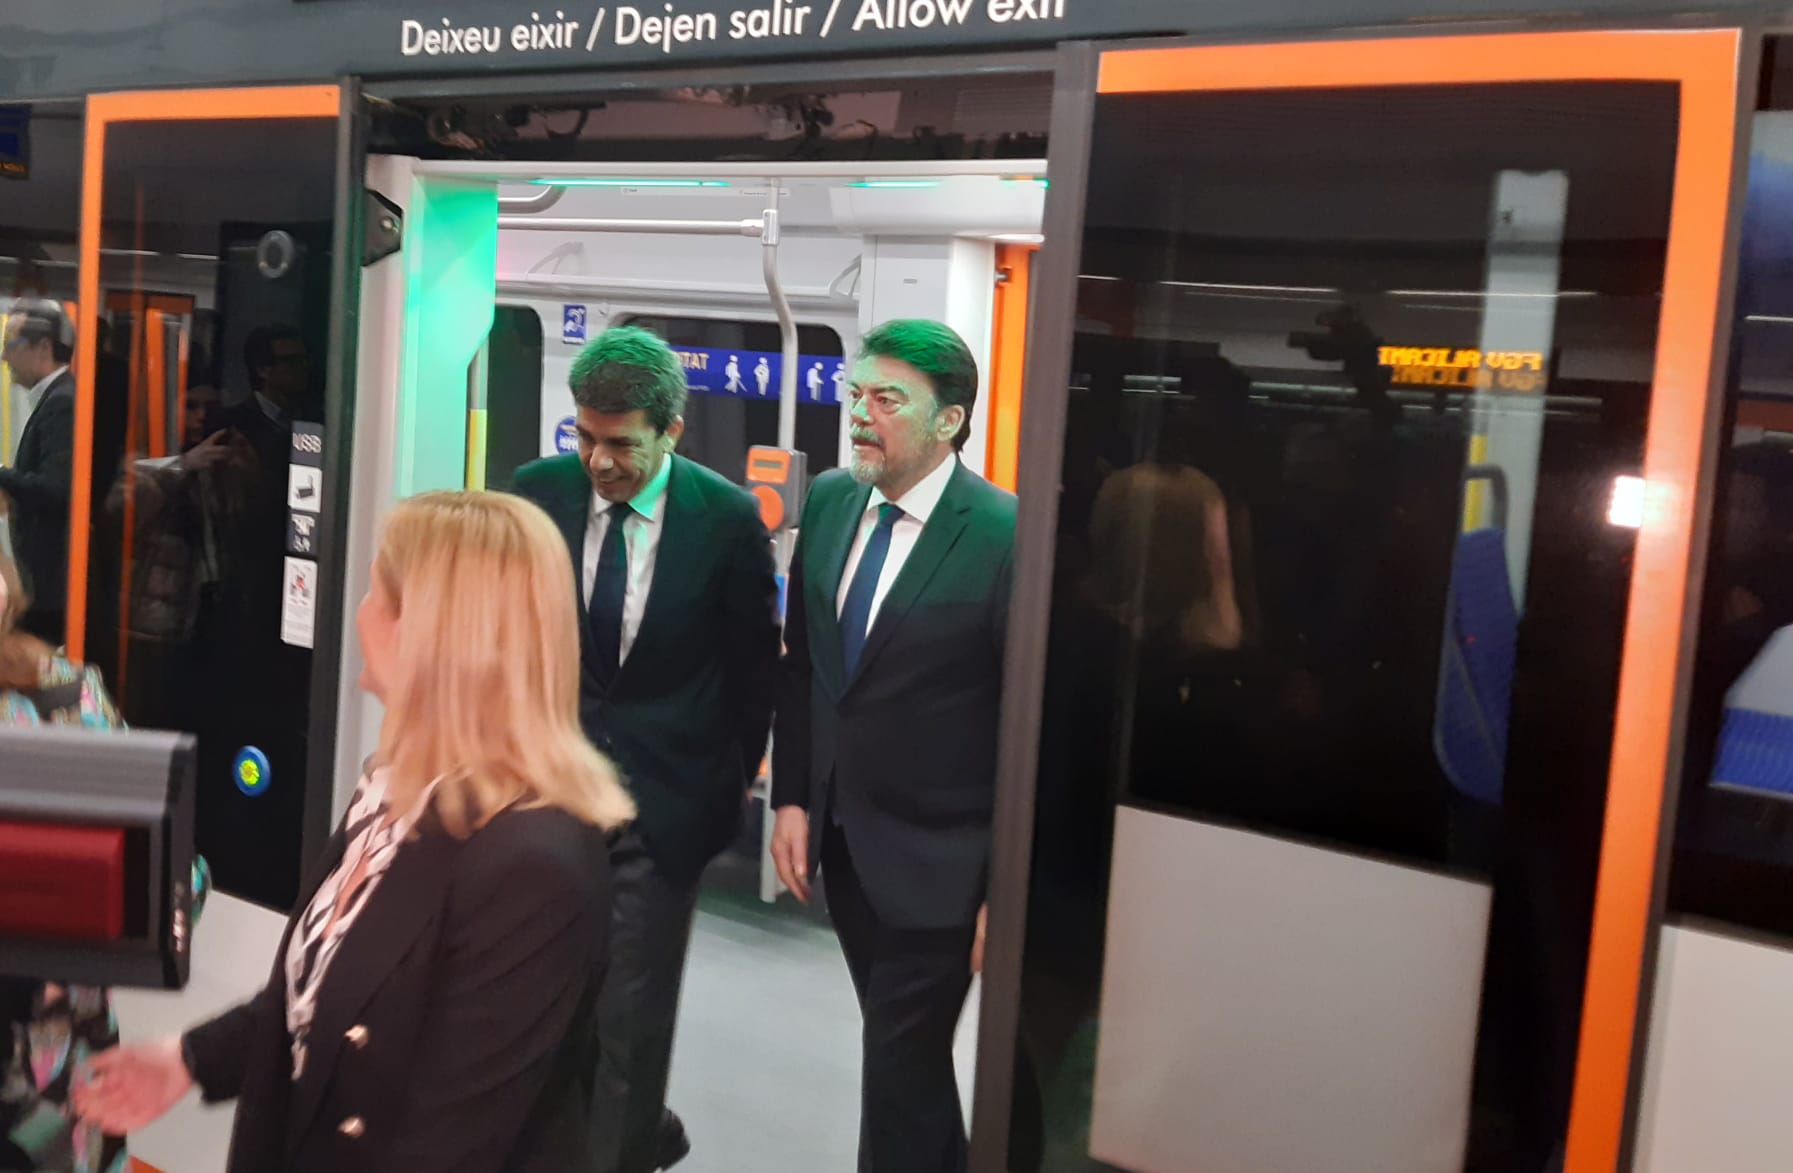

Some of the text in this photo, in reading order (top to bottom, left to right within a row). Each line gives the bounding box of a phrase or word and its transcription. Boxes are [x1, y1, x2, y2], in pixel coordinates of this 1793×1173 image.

[401, 17, 500, 56] Deixeu
[510, 10, 579, 51] eixir
[615, 3, 717, 53] Dejen
[728, 0, 812, 39] salir
[851, 0, 974, 31] Allow
